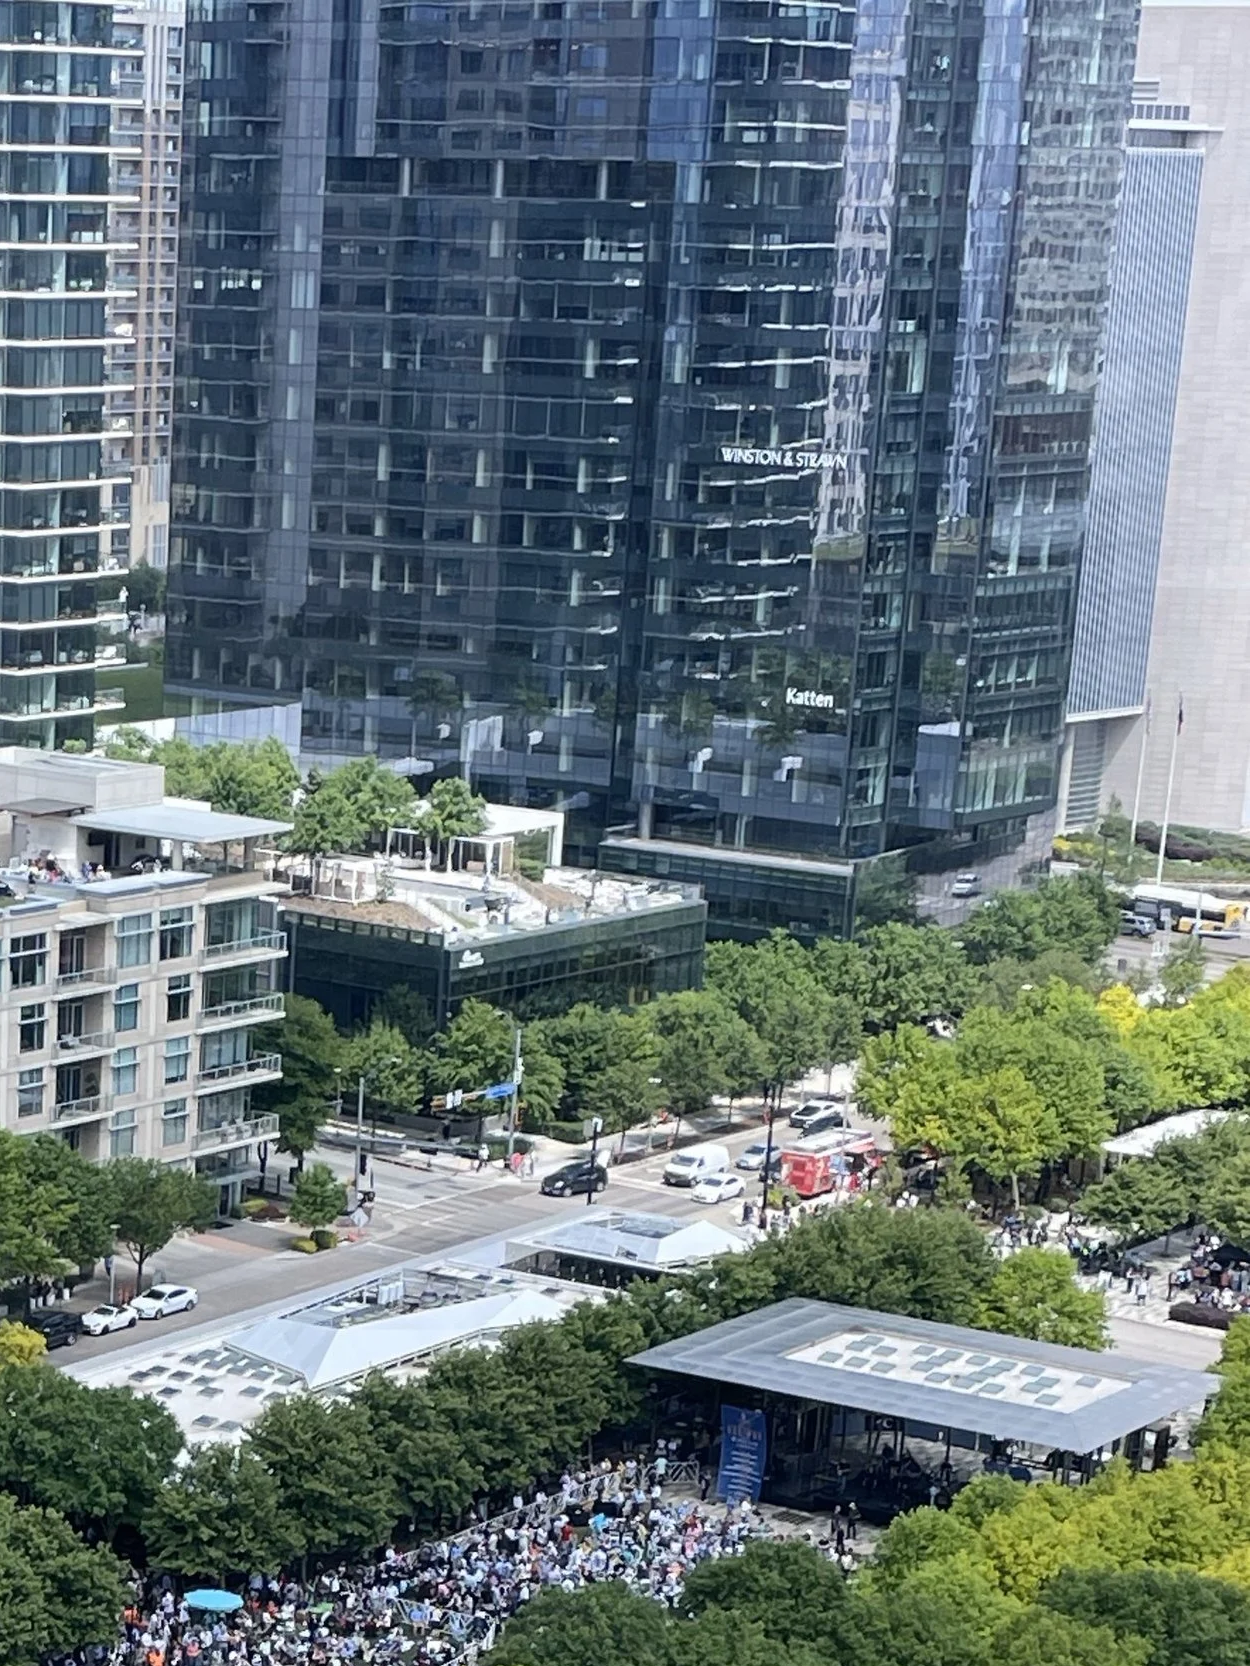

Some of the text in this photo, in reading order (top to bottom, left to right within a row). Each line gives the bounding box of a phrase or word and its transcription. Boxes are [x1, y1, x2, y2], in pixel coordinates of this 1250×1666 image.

[721, 447, 848, 469] WINSTON & STRAWN
[786, 687, 833, 708] Katten
